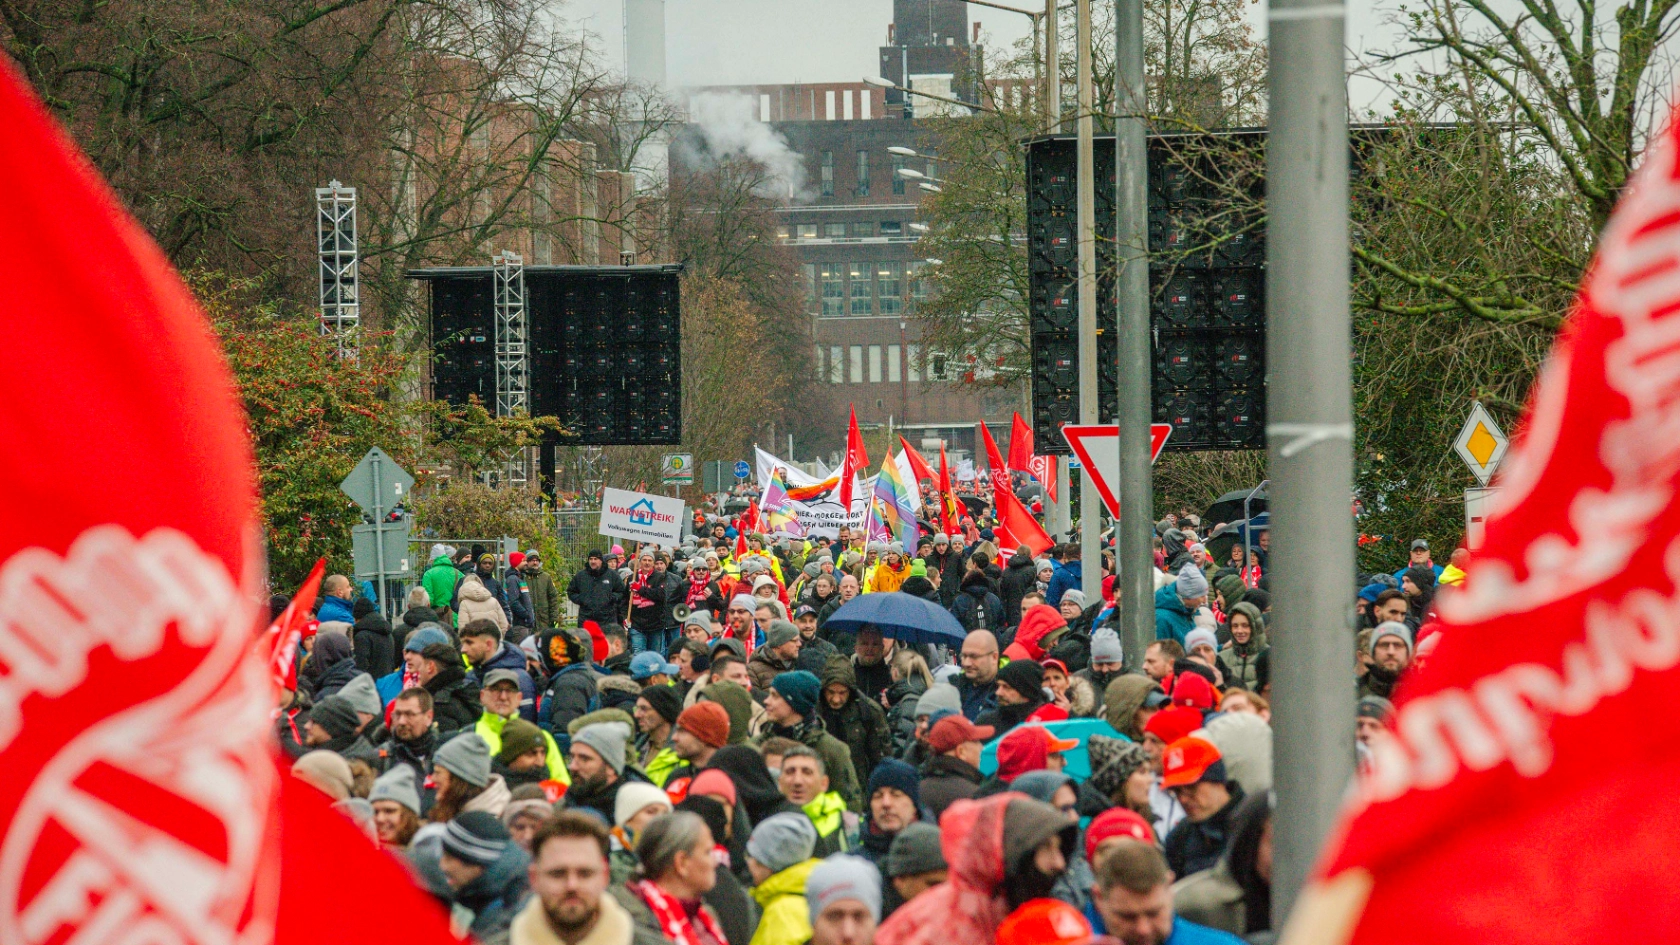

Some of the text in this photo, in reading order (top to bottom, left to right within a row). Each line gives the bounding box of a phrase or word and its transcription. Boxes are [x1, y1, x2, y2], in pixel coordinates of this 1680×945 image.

[609, 505, 675, 523] WARNSTREIK!
[815, 512, 844, 520] MORGEN
[607, 523, 674, 539] Volkswagen Immobilien
